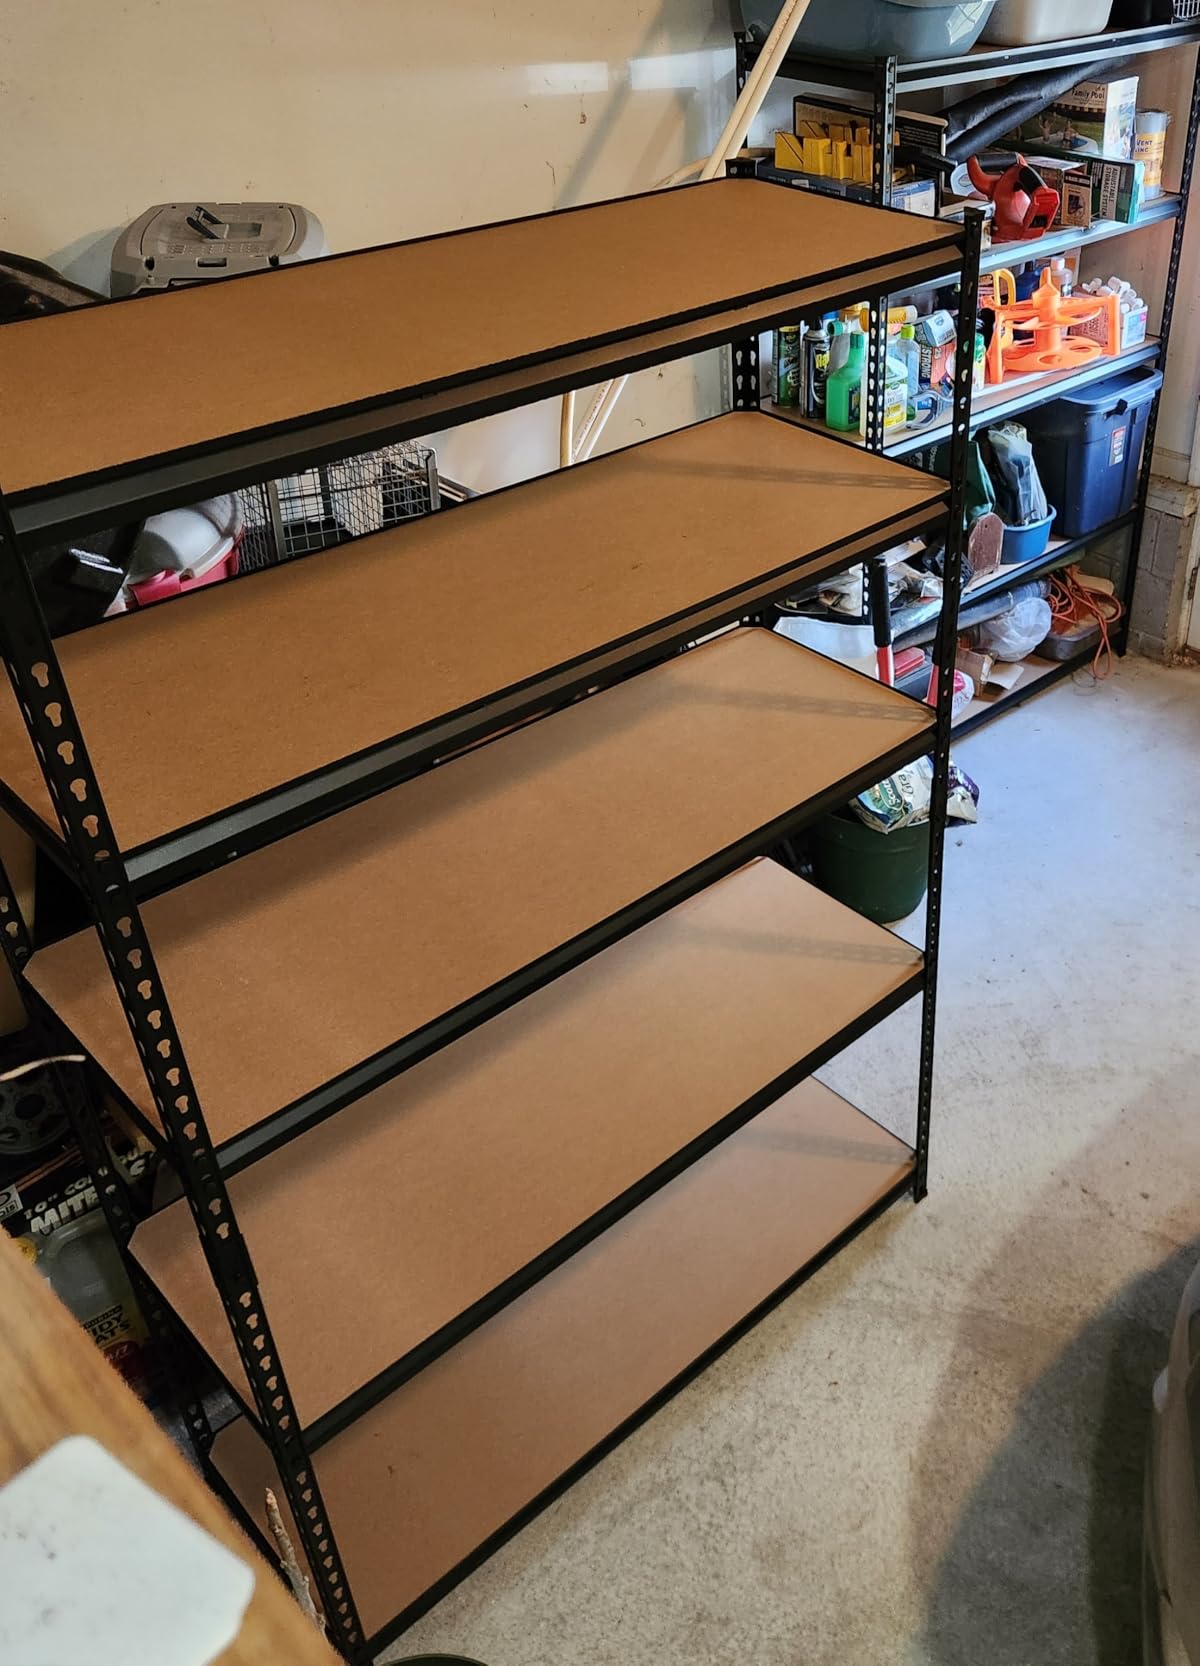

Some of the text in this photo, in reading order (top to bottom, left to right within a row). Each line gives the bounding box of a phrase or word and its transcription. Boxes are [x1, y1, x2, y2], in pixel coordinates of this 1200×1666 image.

[1072, 87, 1090, 99] Family
[1091, 90, 1105, 99] Pool
[1103, 166, 1112, 195] STORAGE
[1109, 167, 1119, 203] ADJUSTABLE
[90, 1312, 124, 1337] IDY
[95, 1320, 130, 1345] ATS
